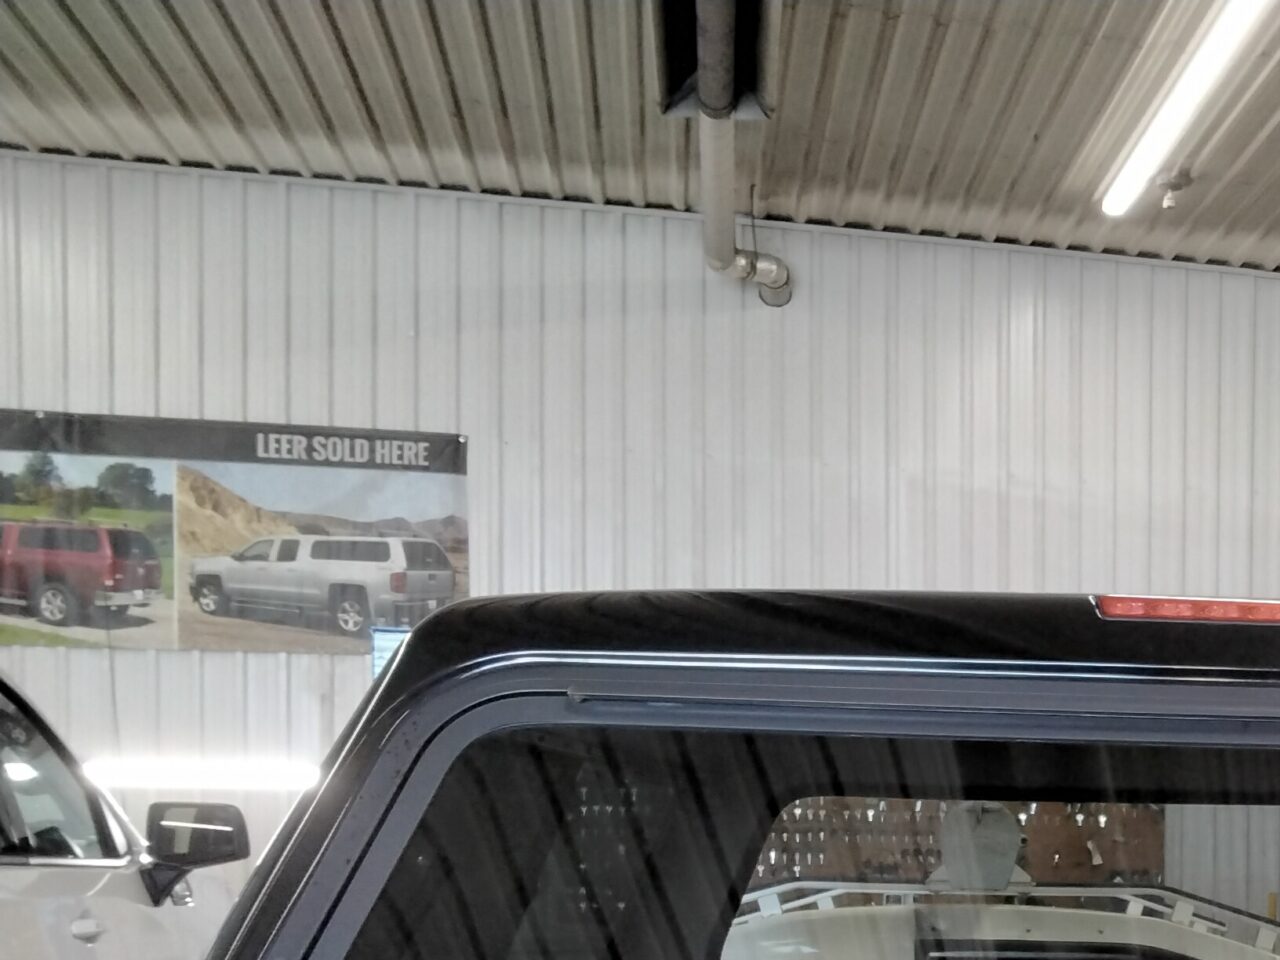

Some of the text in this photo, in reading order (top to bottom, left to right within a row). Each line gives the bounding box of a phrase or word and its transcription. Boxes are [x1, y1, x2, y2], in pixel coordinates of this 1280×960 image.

[256, 432, 430, 466] LEER SOLD HERE
